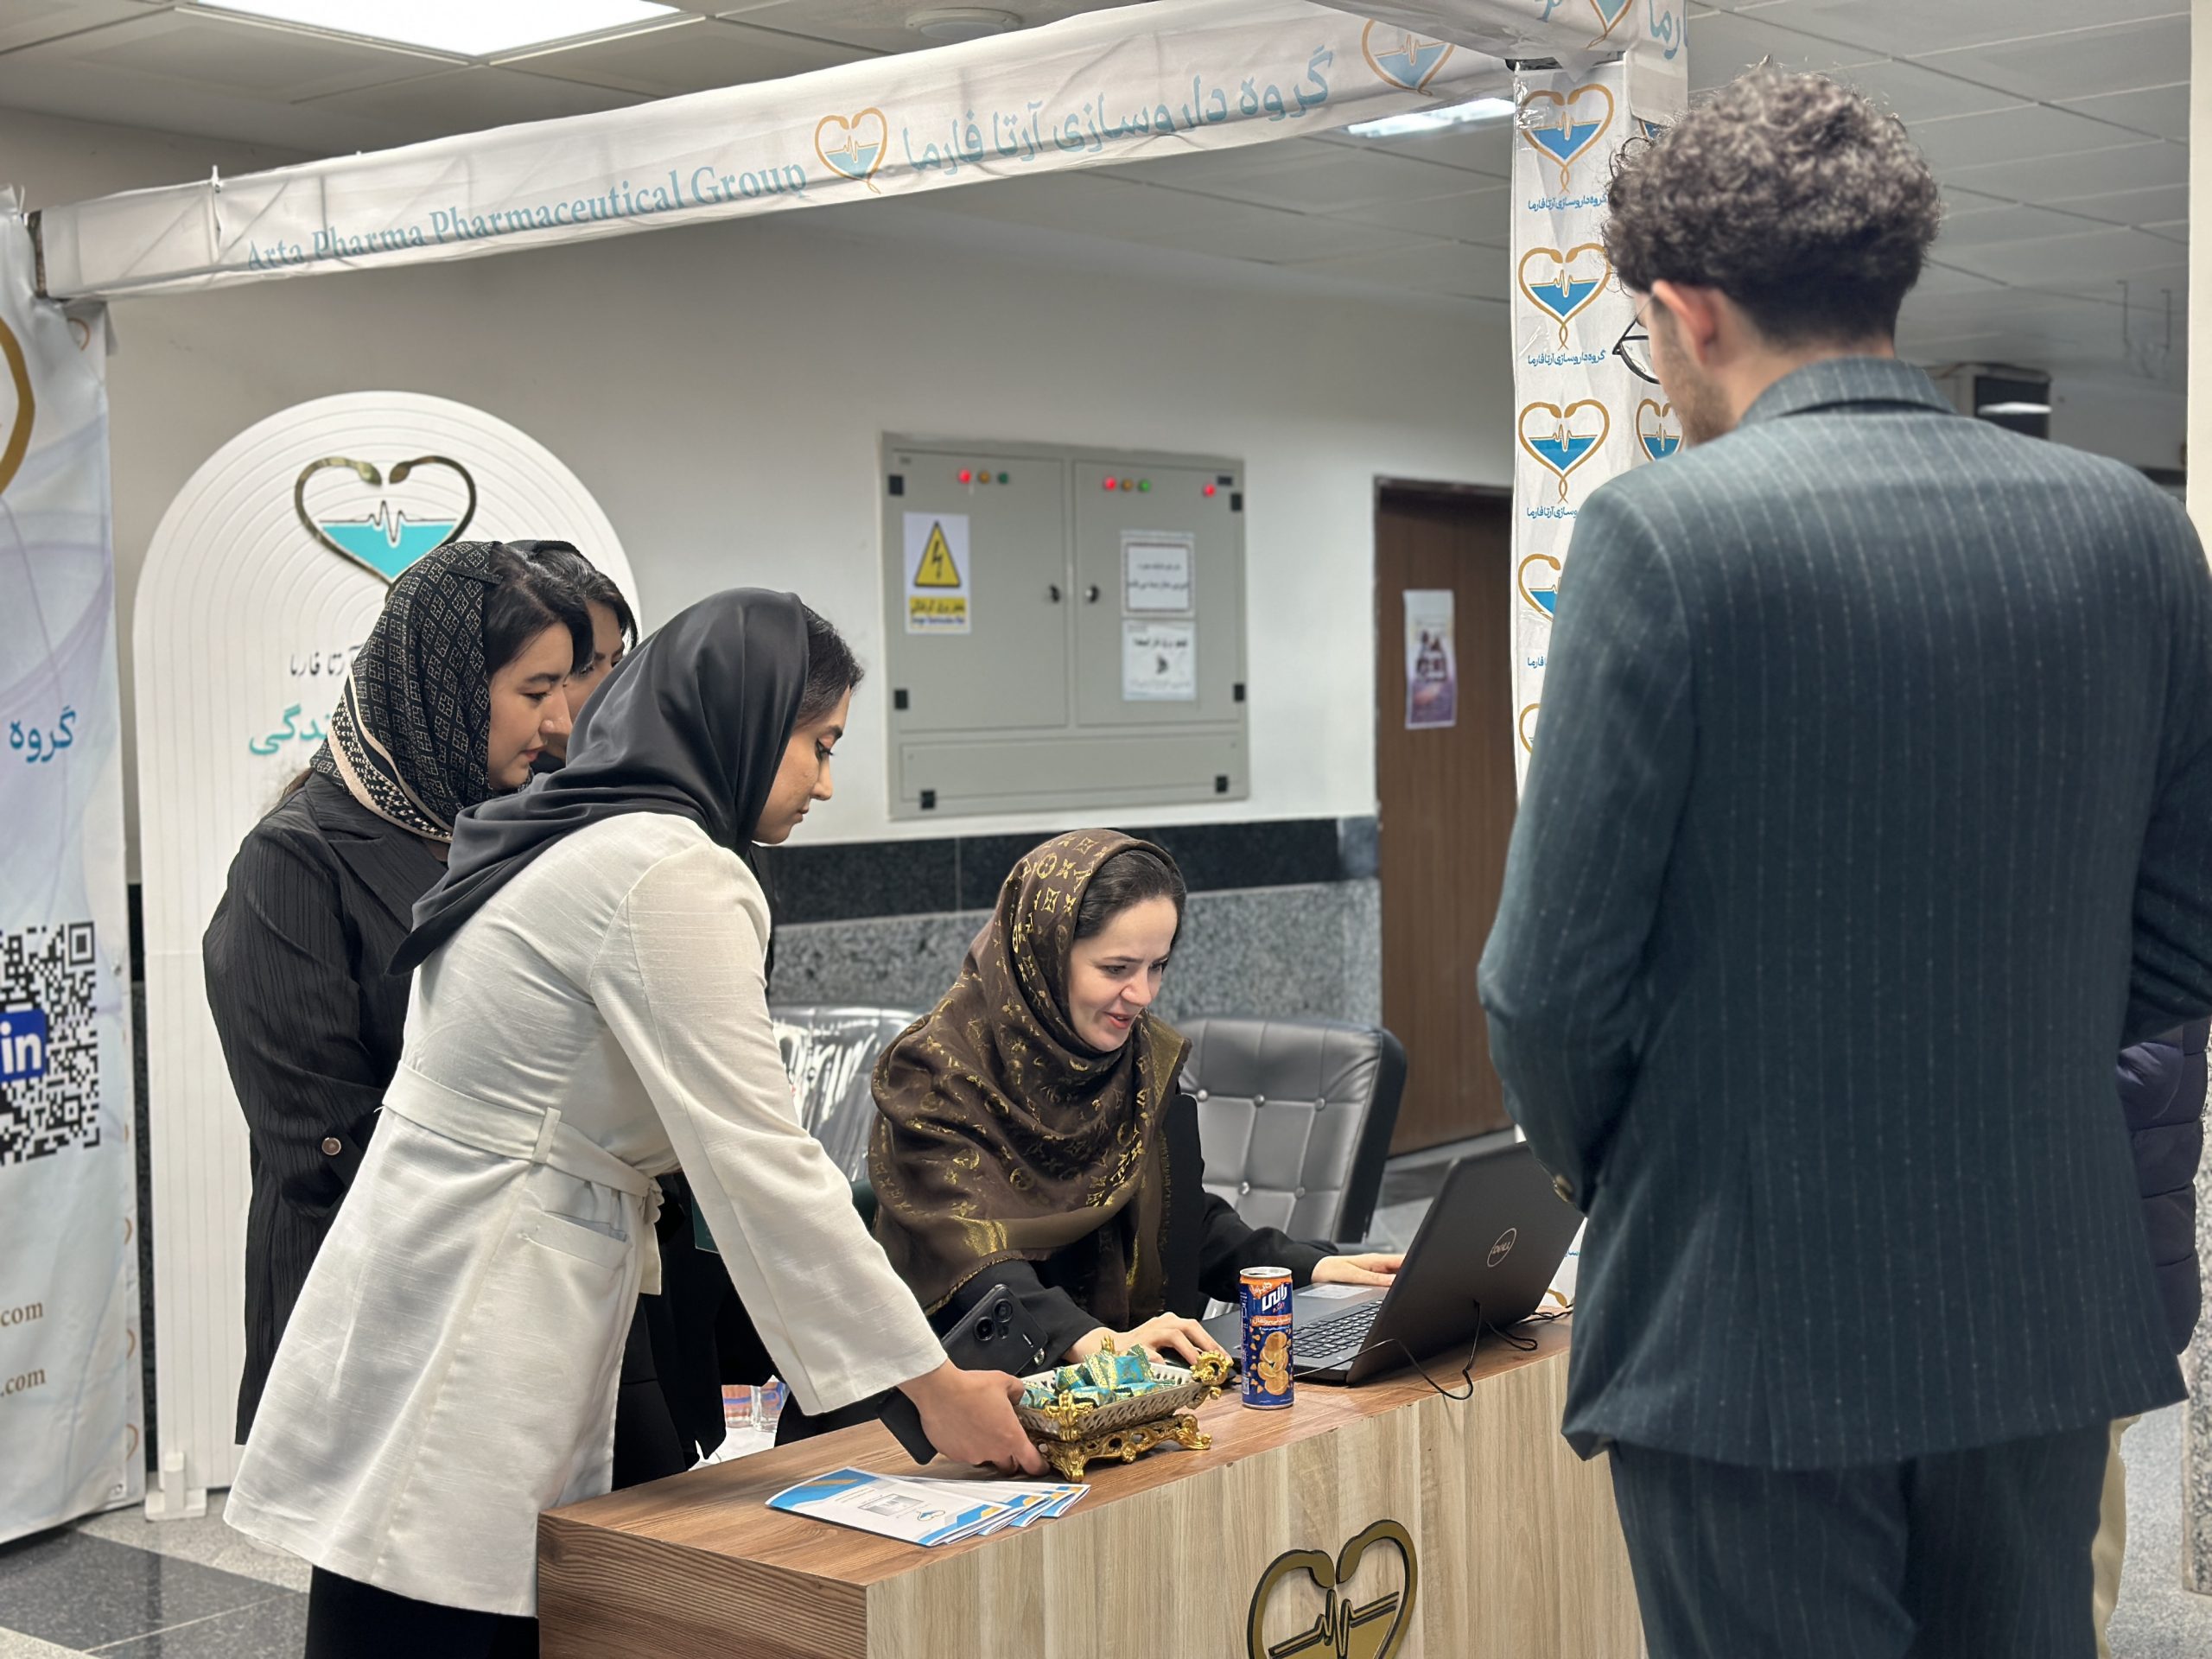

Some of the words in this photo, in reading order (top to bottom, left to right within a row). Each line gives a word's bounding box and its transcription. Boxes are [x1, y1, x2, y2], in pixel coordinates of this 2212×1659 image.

[1240, 45, 1334, 121] گروه
[1052, 76, 1228, 154] داروسازی
[902, 109, 984, 175] فارما
[993, 99, 1043, 162] آرتا
[248, 240, 302, 270] Arta
[313, 224, 426, 262] Pharma
[430, 170, 683, 243] Pharmaceutical
[690, 164, 807, 207] Group
[1528, 197, 1545, 212] فارما
[1528, 353, 1544, 366] فارما
[1527, 506, 1543, 518] فارما
[1543, 506, 1554, 518] آرتا
[1554, 506, 1577, 518] وسازی
[290, 652, 321, 677] فارما
[1527, 656, 1544, 669] فارما
[10, 705, 76, 764] گروه
[249, 703, 332, 756] ندگی
[0, 1021, 42, 1075] in
[0, 1302, 43, 1327] com
[0, 1369, 46, 1397] .com
